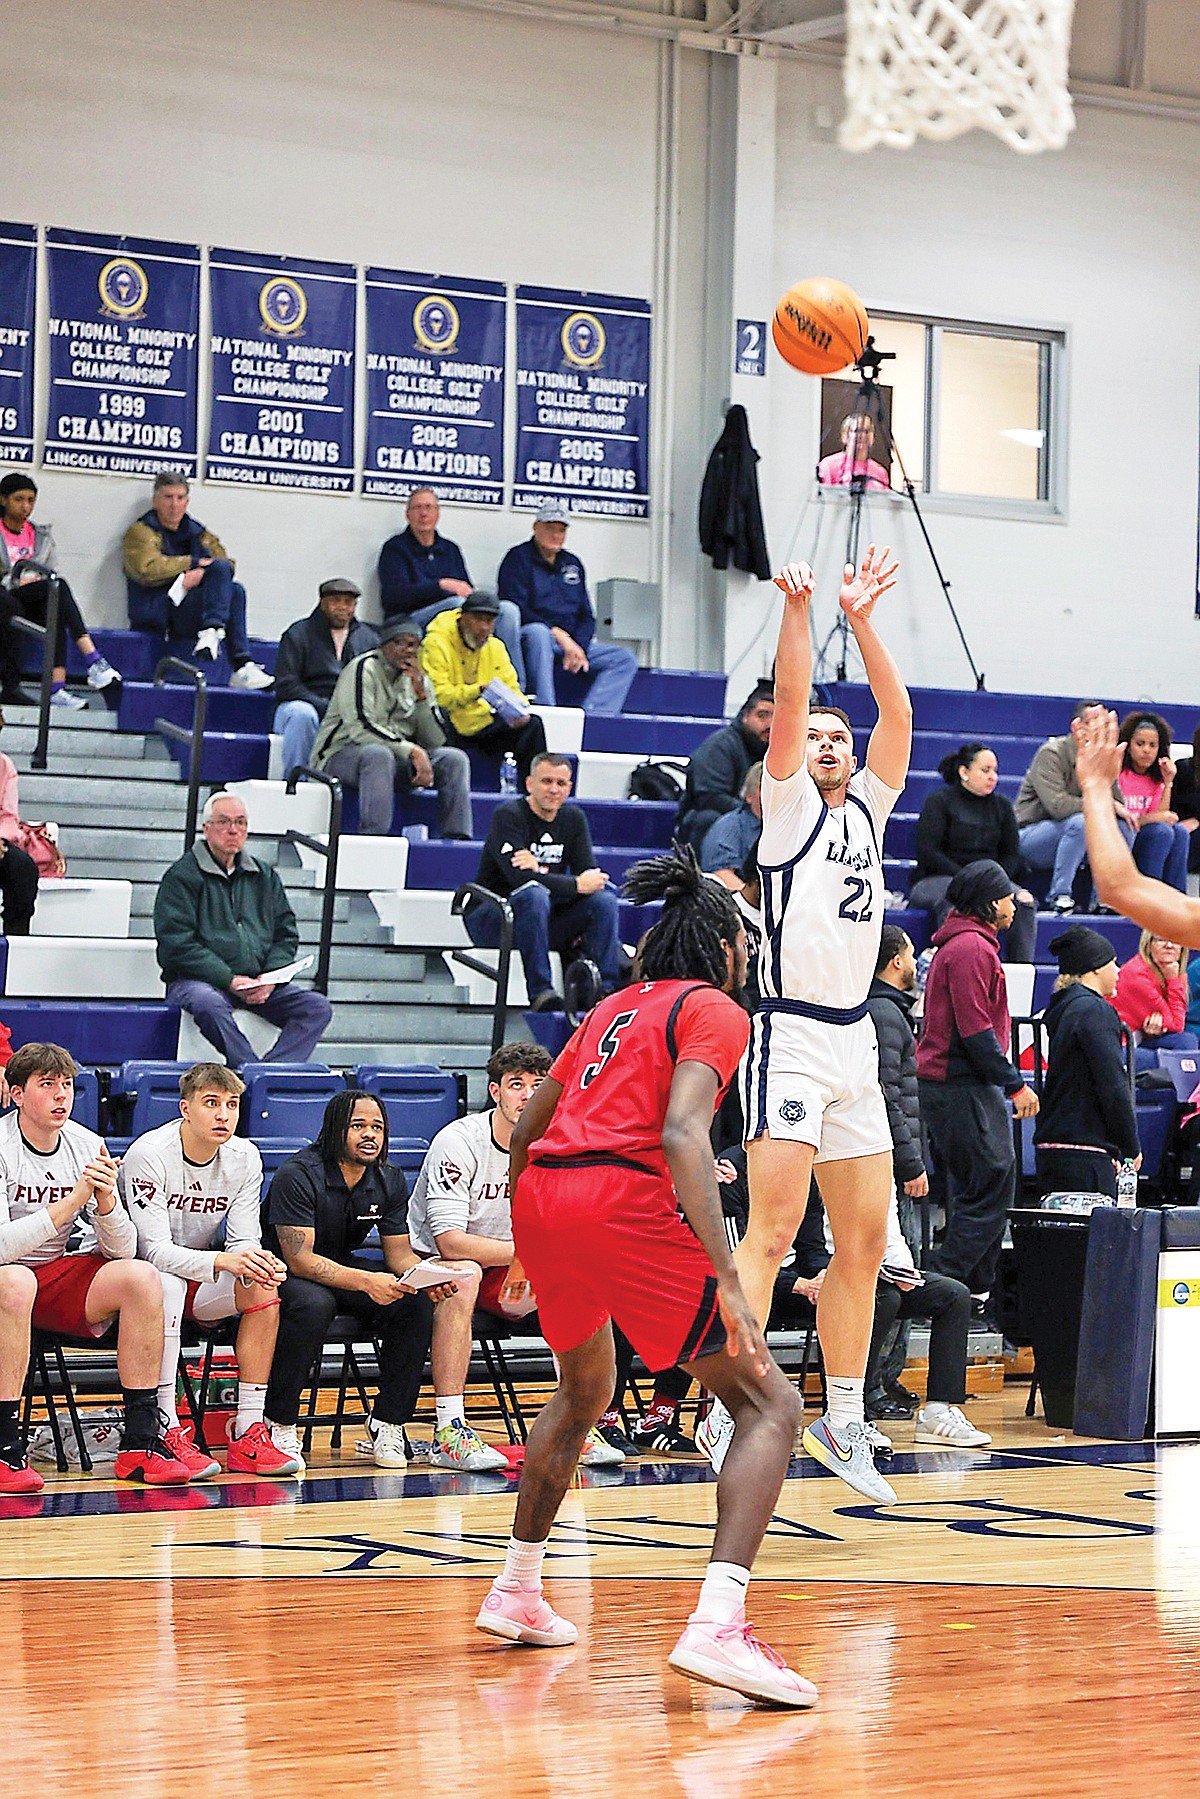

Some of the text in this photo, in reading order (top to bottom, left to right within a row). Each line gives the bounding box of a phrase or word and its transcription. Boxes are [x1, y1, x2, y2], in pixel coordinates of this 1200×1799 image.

[48, 318, 197, 350] NATIONAL MINORITY
[742, 325, 760, 359] 2
[69, 341, 174, 367] COLLEGE GOLF
[210, 336, 353, 367] NATIONAL MINORITY
[71, 360, 172, 386] CHAMPIONSHIP
[231, 358, 332, 384] COLLEGE GOLF
[366, 353, 503, 383] NATIONAL MINORITY
[233, 376, 330, 402] CHAMPIONSHIP
[386, 374, 483, 399] COLLEGE GOLF
[516, 369, 648, 398] NATIONAL MINORITY
[98, 392, 147, 419] 1999
[388, 393, 481, 416] CHAMPIONSHIP
[535, 389, 629, 413] COLLEGE GOLF
[258, 408, 305, 434] 2001
[538, 407, 627, 430] CHAMPIONSHIP
[57, 415, 183, 449] CHAMPIONS
[411, 424, 459, 448] 2002
[219, 431, 341, 463] CHAMPIONS
[559, 438, 605, 461] 2005
[45, 450, 193, 478] LINCOLN UNIVERSITY
[376, 446, 491, 477] CHAMPIONS
[208, 465, 350, 490] LINCOLN UNIVERSITY
[365, 480, 418, 496] LINCOL
[525, 460, 637, 490] CHAMPIONS
[570, 497, 646, 516] UNIVERSITY
[838, 875, 873, 922] 22
[580, 1008, 639, 1090] 5
[166, 1193, 229, 1214] FLYERS
